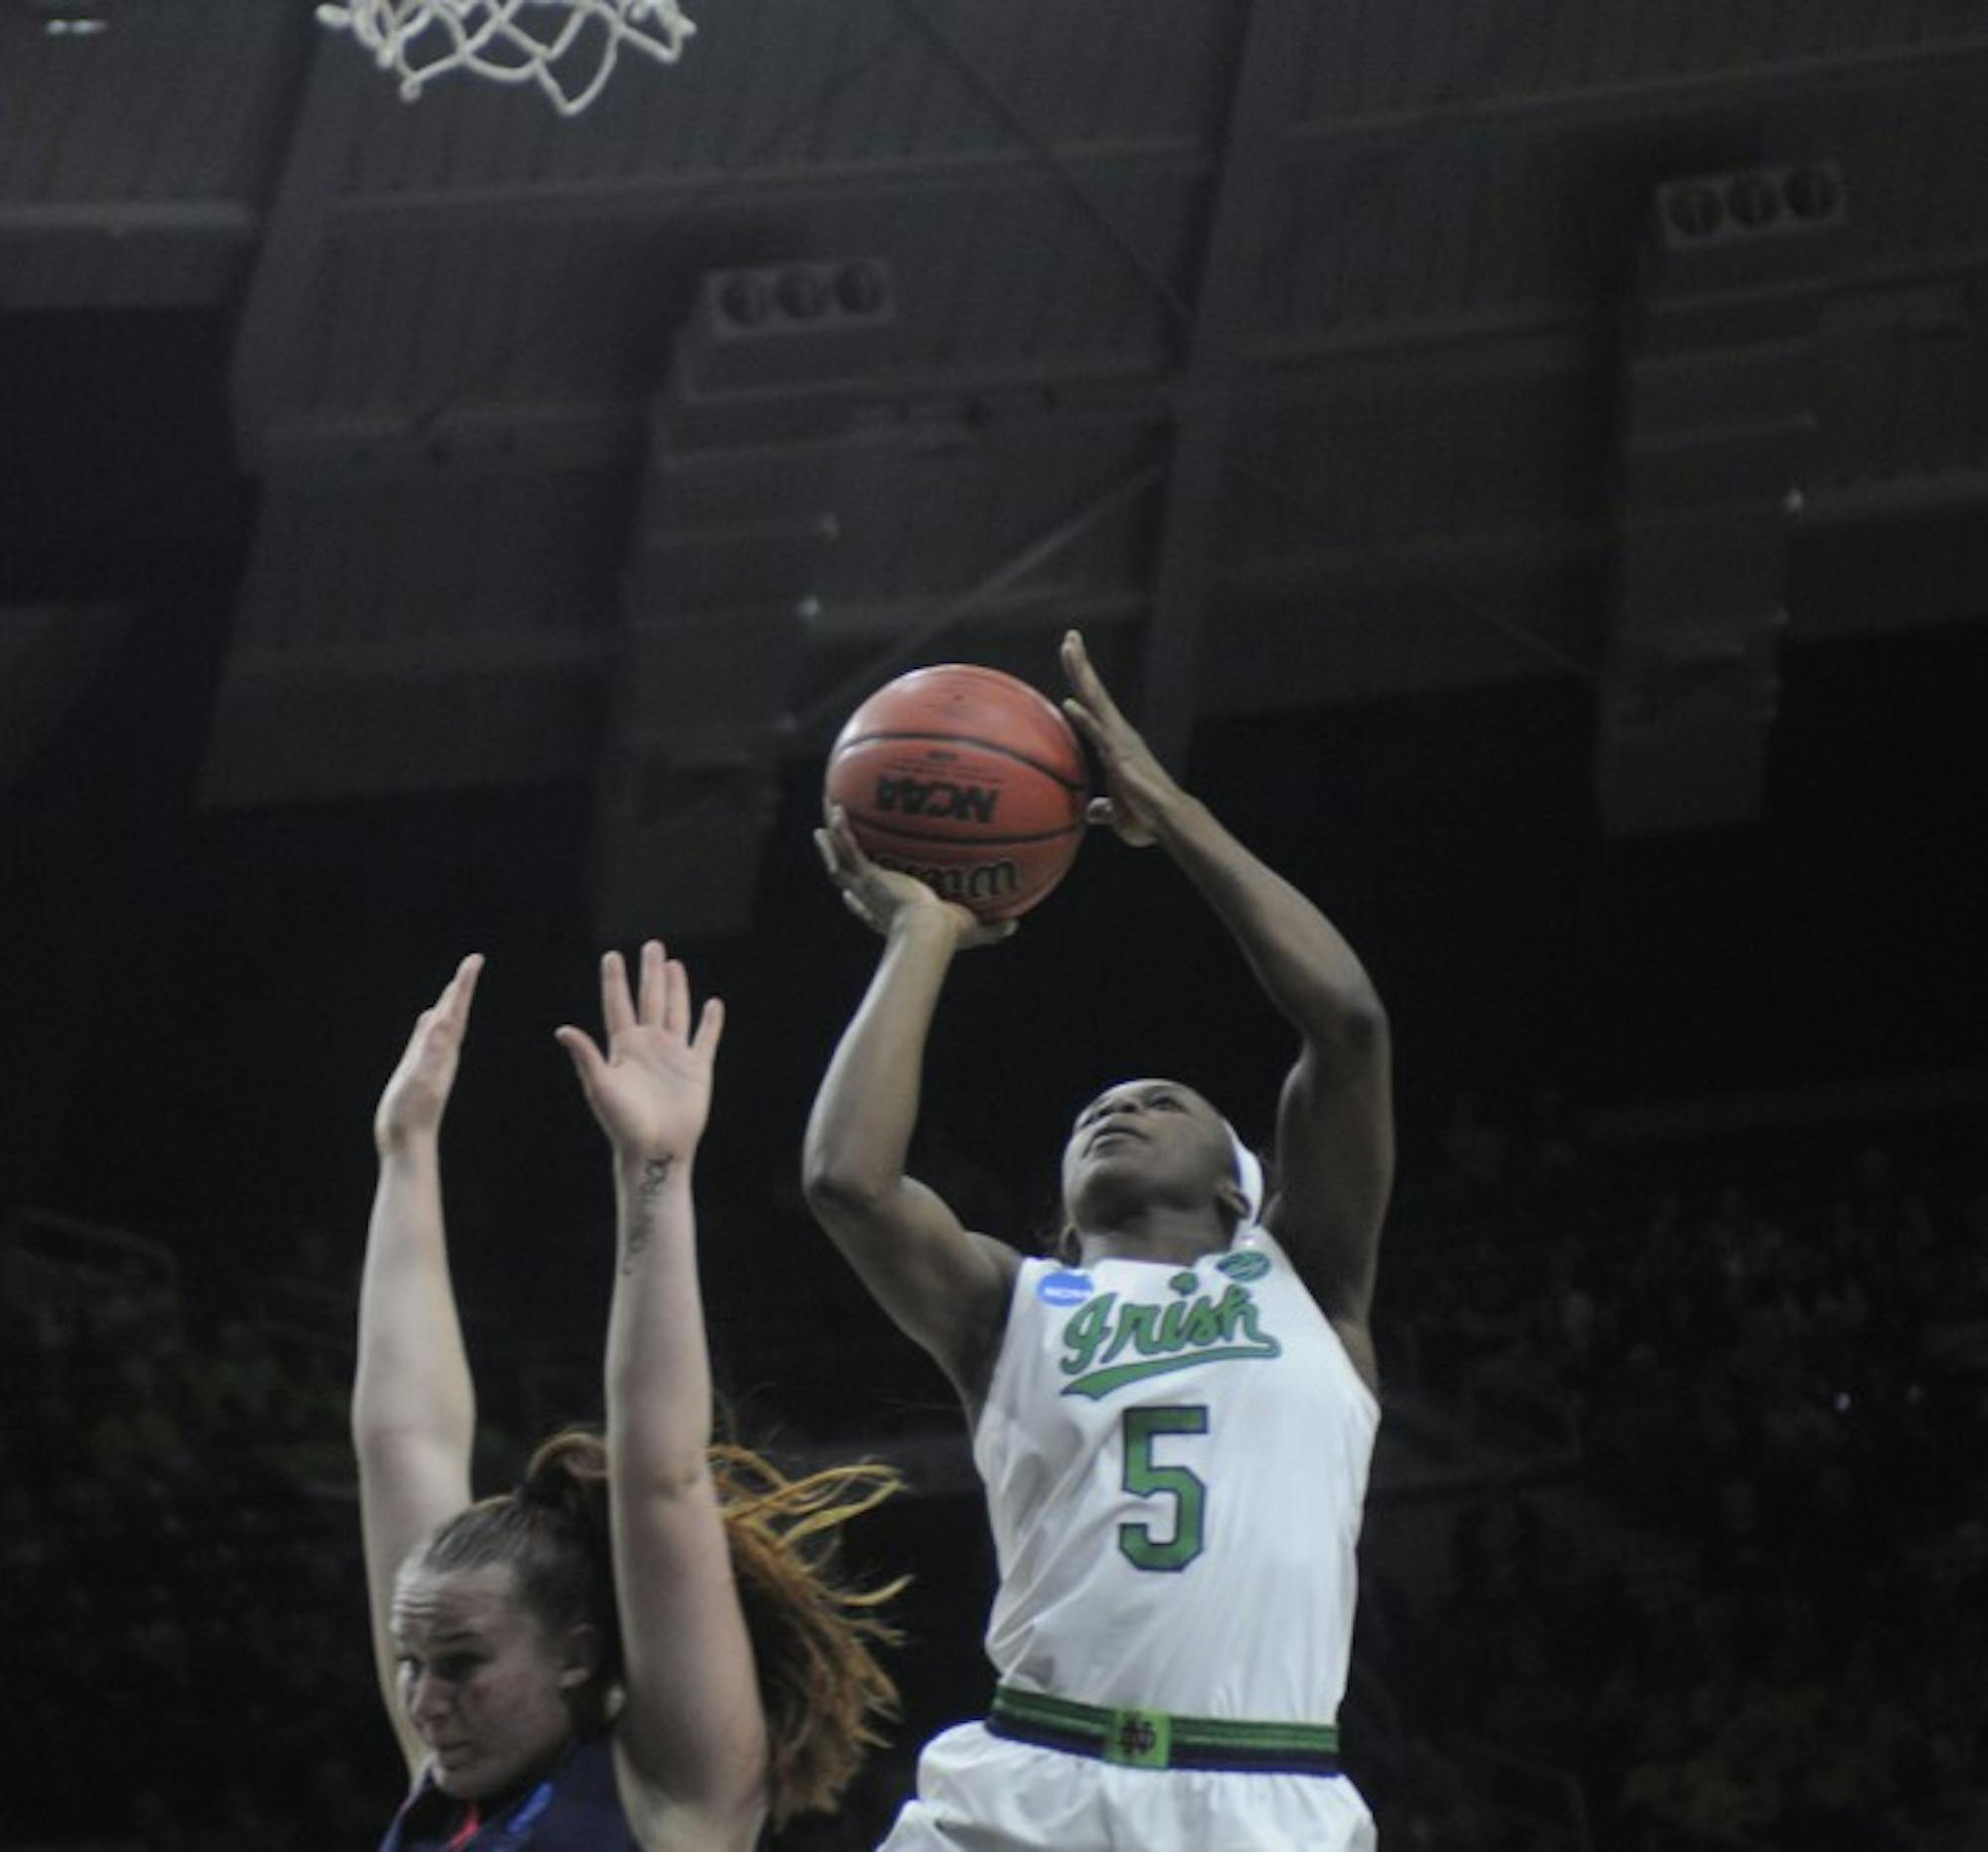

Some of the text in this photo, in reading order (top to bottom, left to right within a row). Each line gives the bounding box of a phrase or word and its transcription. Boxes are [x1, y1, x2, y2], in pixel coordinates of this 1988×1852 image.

[878, 776, 998, 823] NCAA
[1060, 1272, 1280, 1376] Irish
[1118, 1405, 1209, 1573] 5
